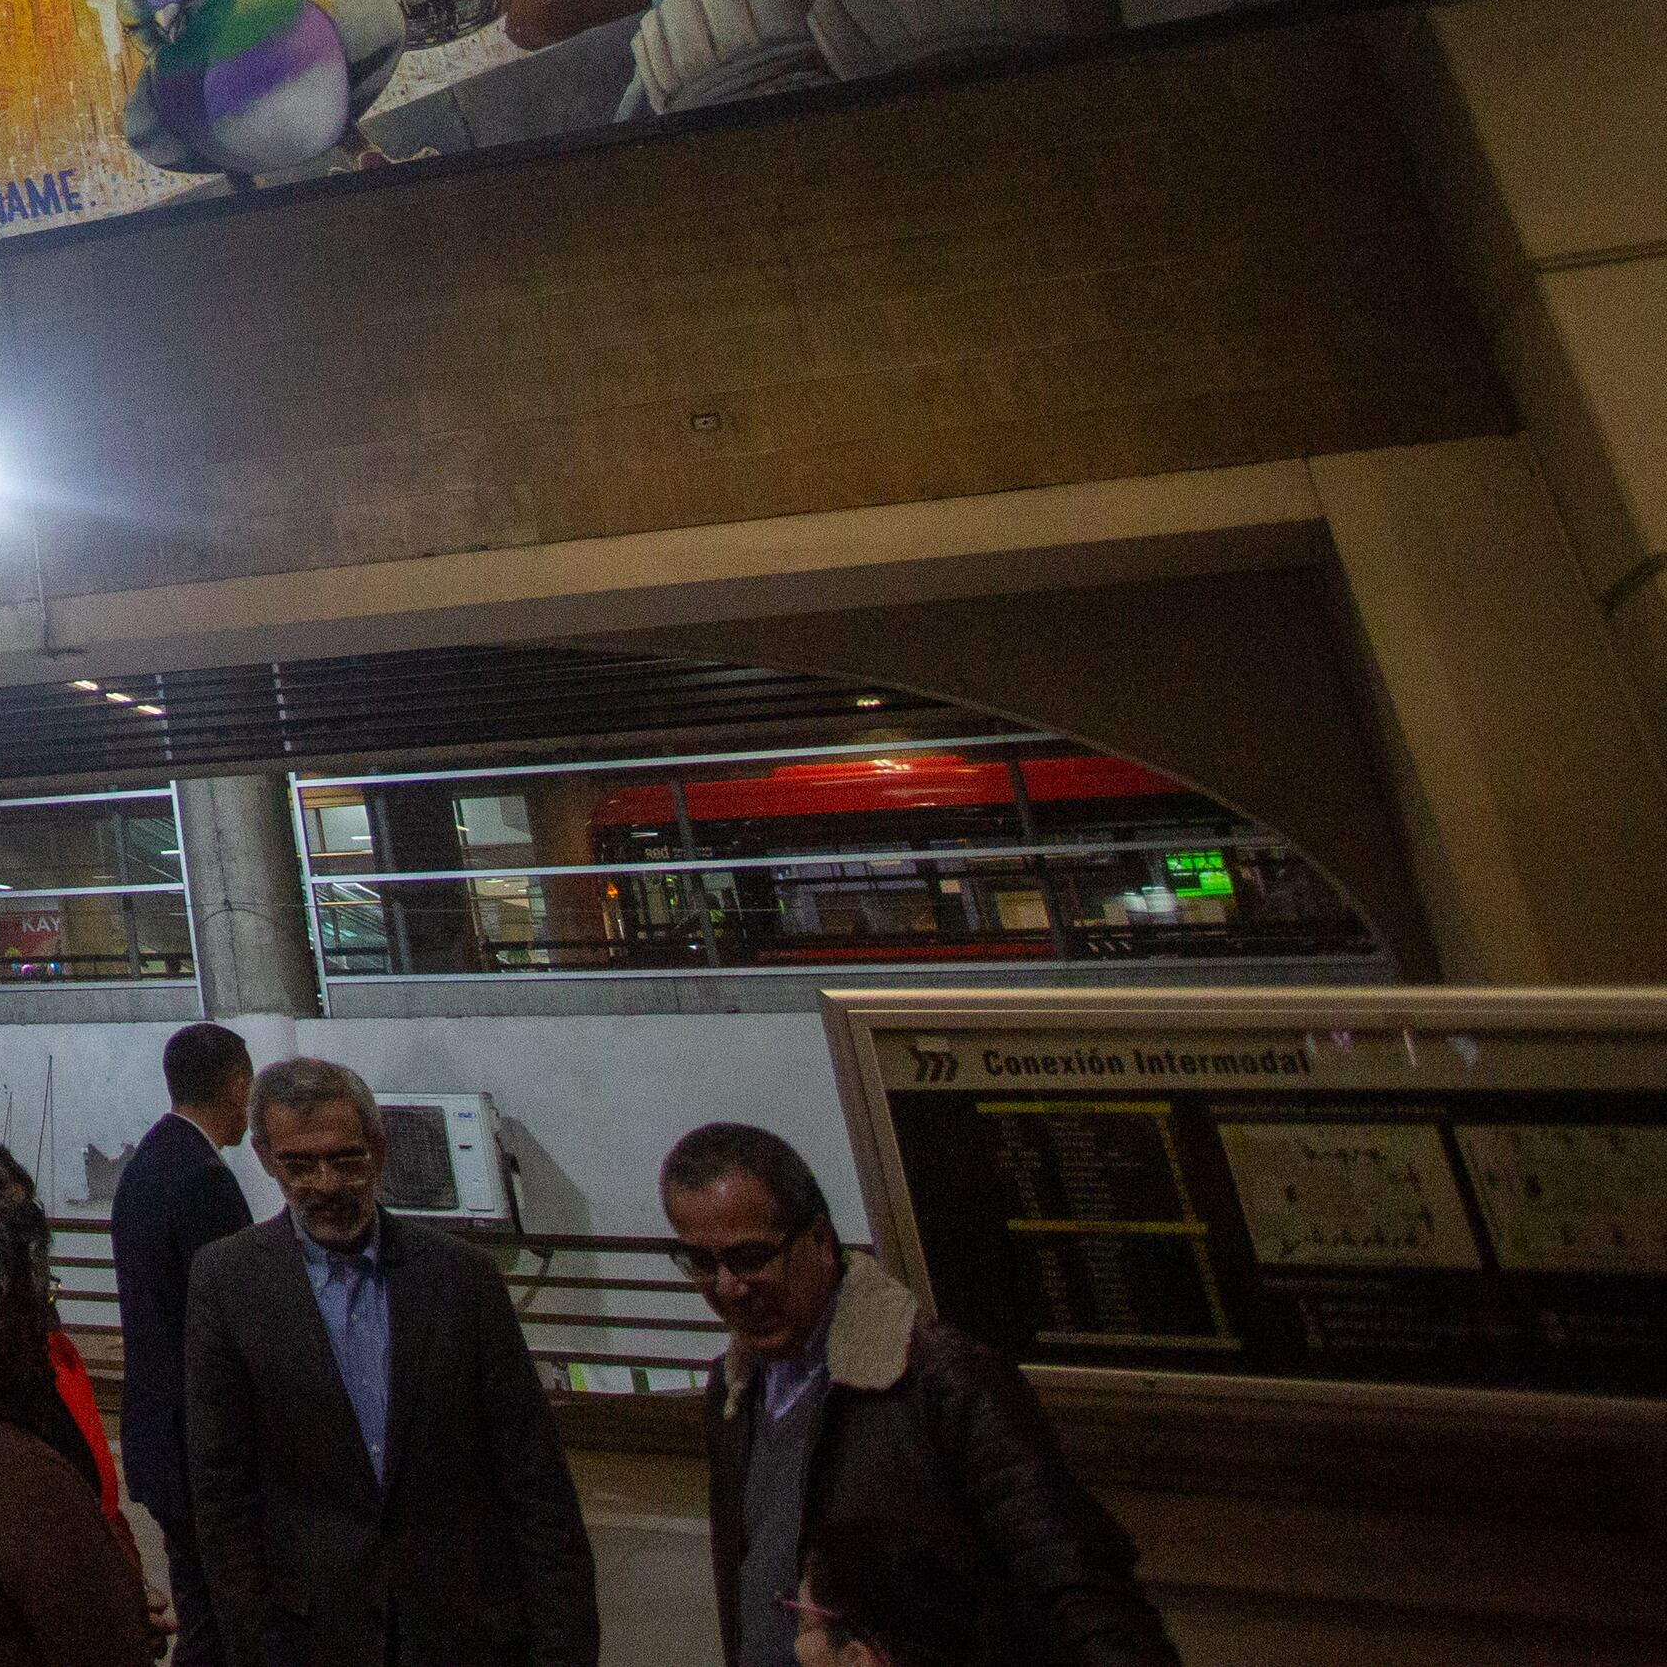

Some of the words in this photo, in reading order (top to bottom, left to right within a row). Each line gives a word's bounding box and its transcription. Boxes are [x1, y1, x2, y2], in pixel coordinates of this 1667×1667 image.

[21, 916, 62, 933] KAY
[982, 1047, 1125, 1076] Conexión
[1134, 1047, 1311, 1075] Intermodal
